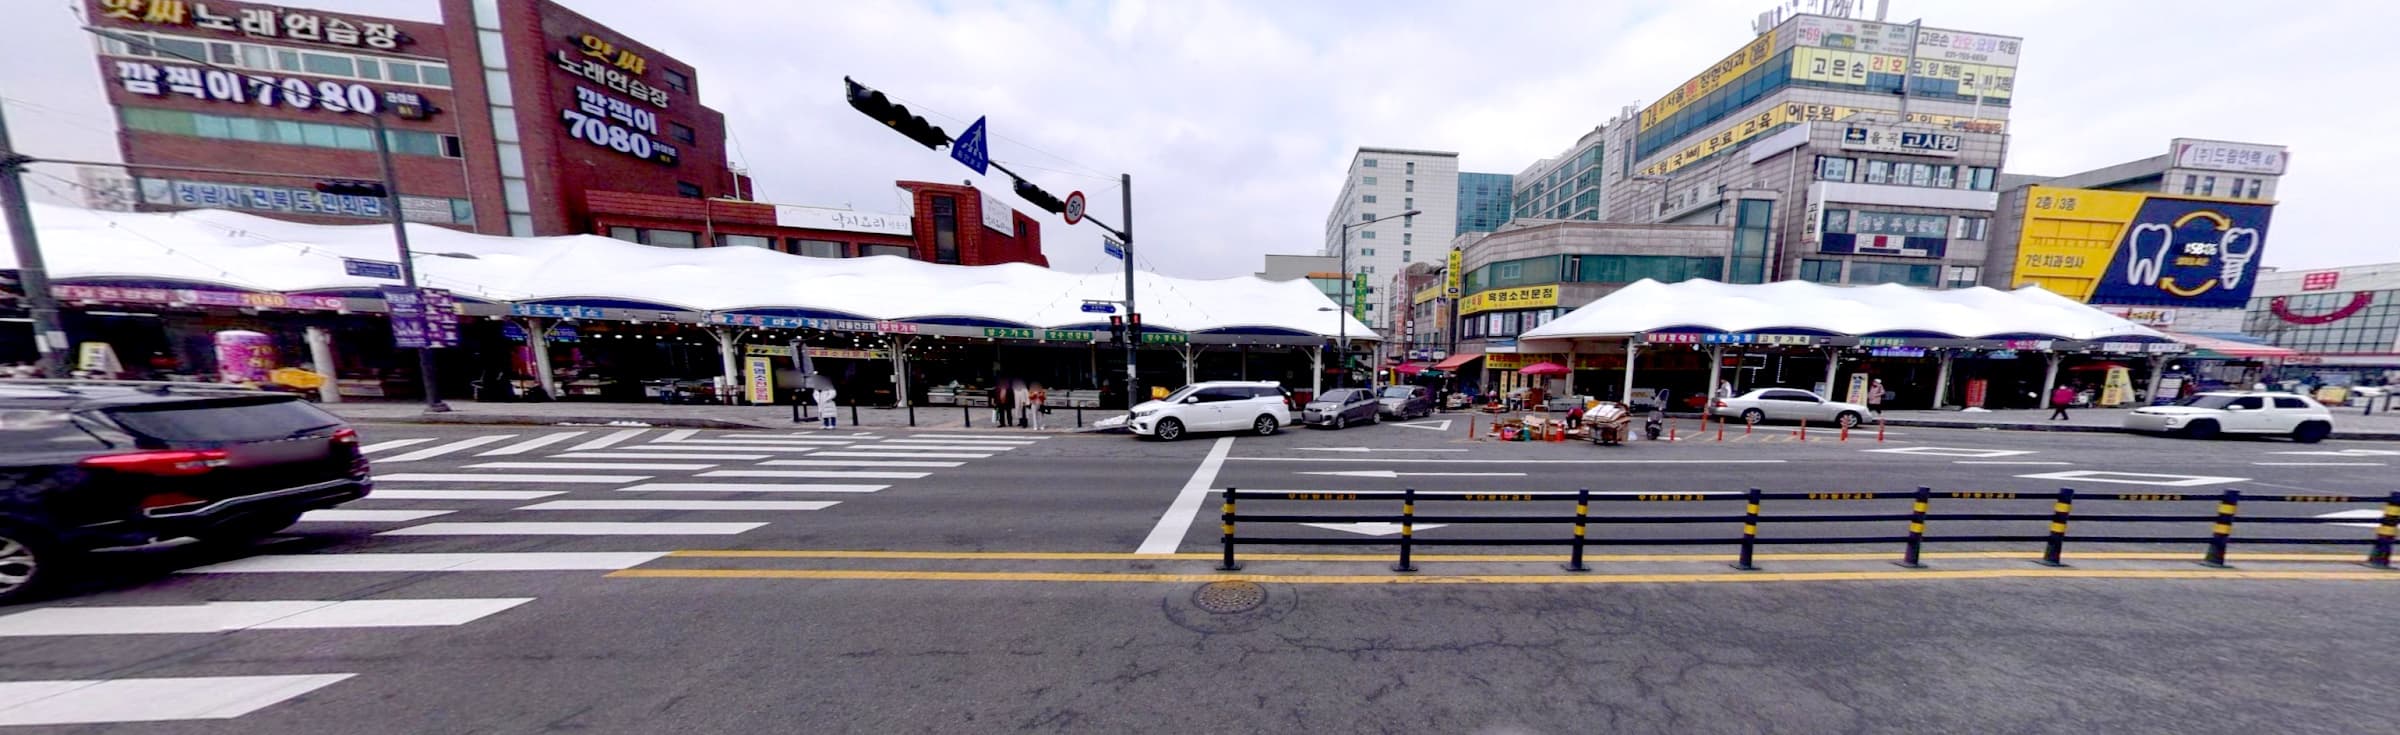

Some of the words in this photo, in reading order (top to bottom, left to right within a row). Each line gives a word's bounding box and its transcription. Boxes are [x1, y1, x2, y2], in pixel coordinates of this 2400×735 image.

[195, 2, 399, 50] 노래연습장
[582, 34, 647, 75] 앗싸
[1812, 57, 1865, 79] 고은손
[1872, 56, 1903, 72] 간호
[116, 61, 245, 103] 깜찍이
[250, 75, 377, 114] 7080
[558, 50, 670, 108] 노래연습장
[576, 85, 658, 136] 깜찍이
[563, 109, 652, 159] 7080
[1903, 133, 1959, 151] 고시원
[179, 183, 242, 207] 성남시
[1068, 201, 1081, 217] 50
